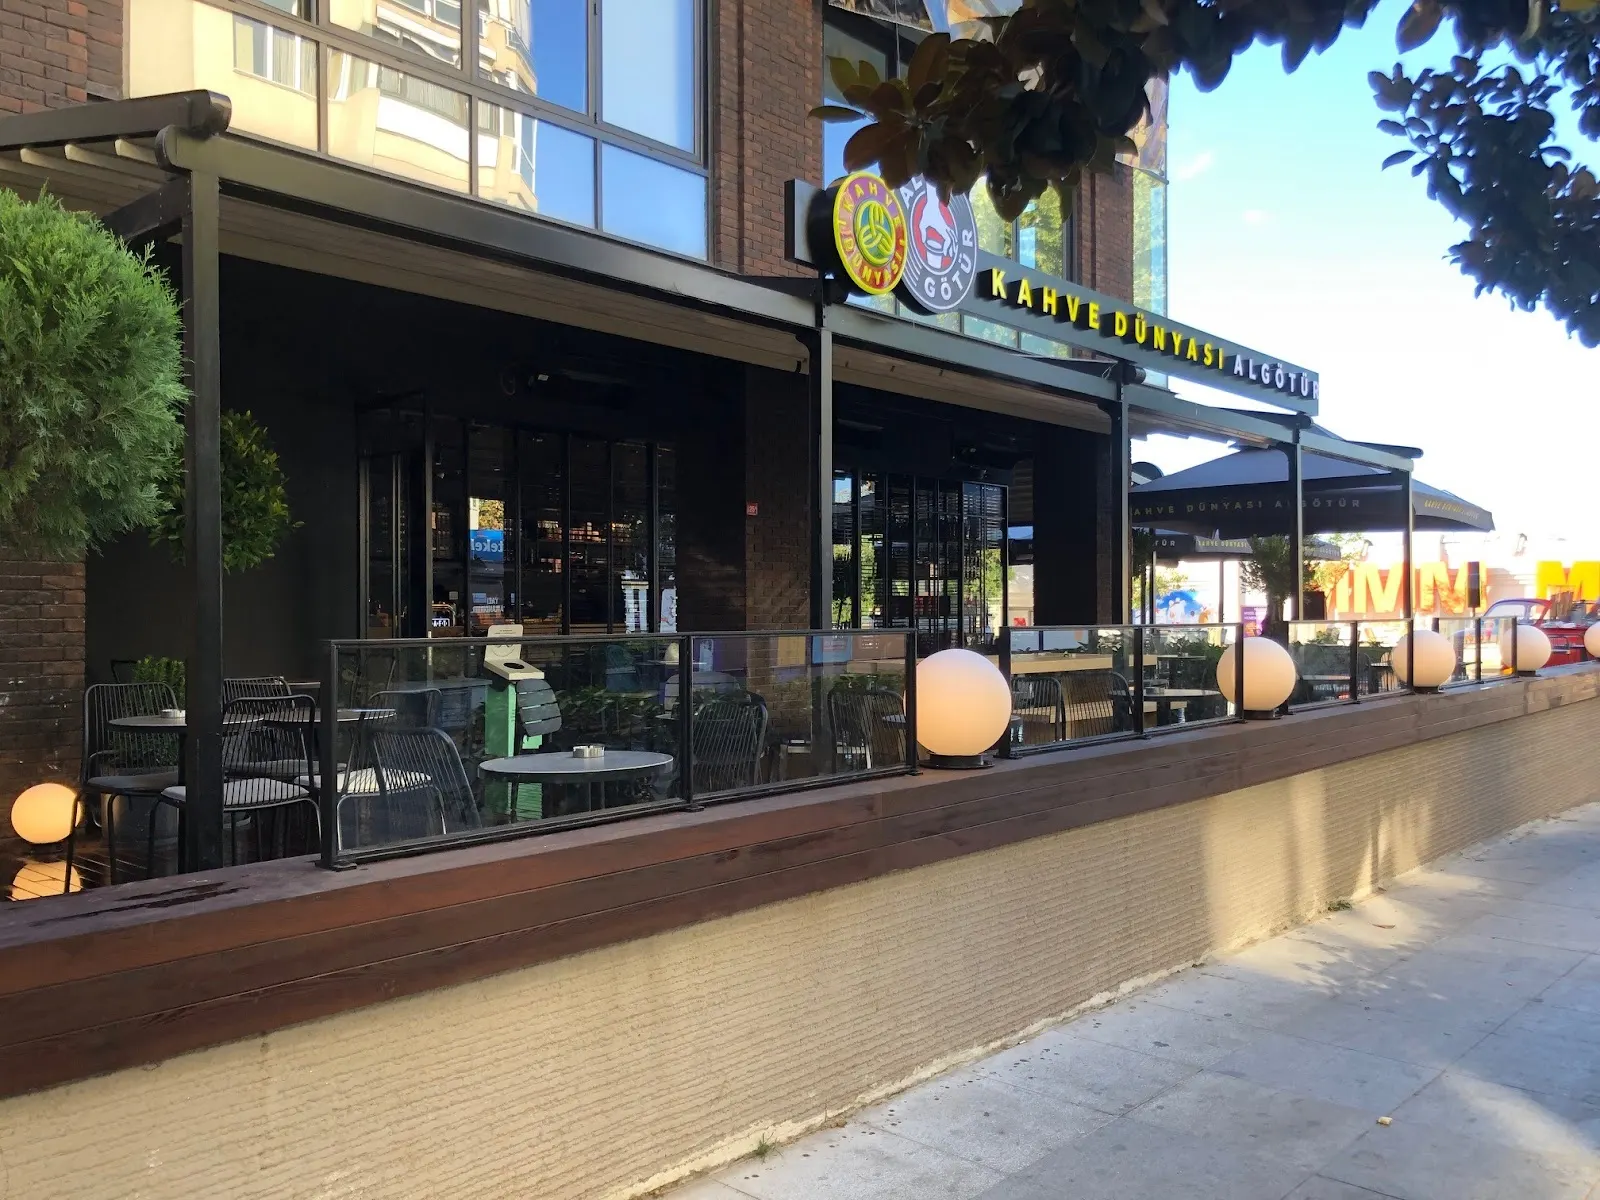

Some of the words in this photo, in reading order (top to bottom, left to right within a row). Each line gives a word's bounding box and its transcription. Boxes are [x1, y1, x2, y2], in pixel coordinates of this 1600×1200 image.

[843, 182, 900, 227] KAHVE
[924, 229, 973, 300] GÖTÜR
[991, 268, 1100, 330] KAHVE
[1114, 311, 1223, 370] DÜNYASI
[1233, 354, 1319, 400] ALGÖTÜR
[1186, 500, 1262, 513] DÜNYASI
